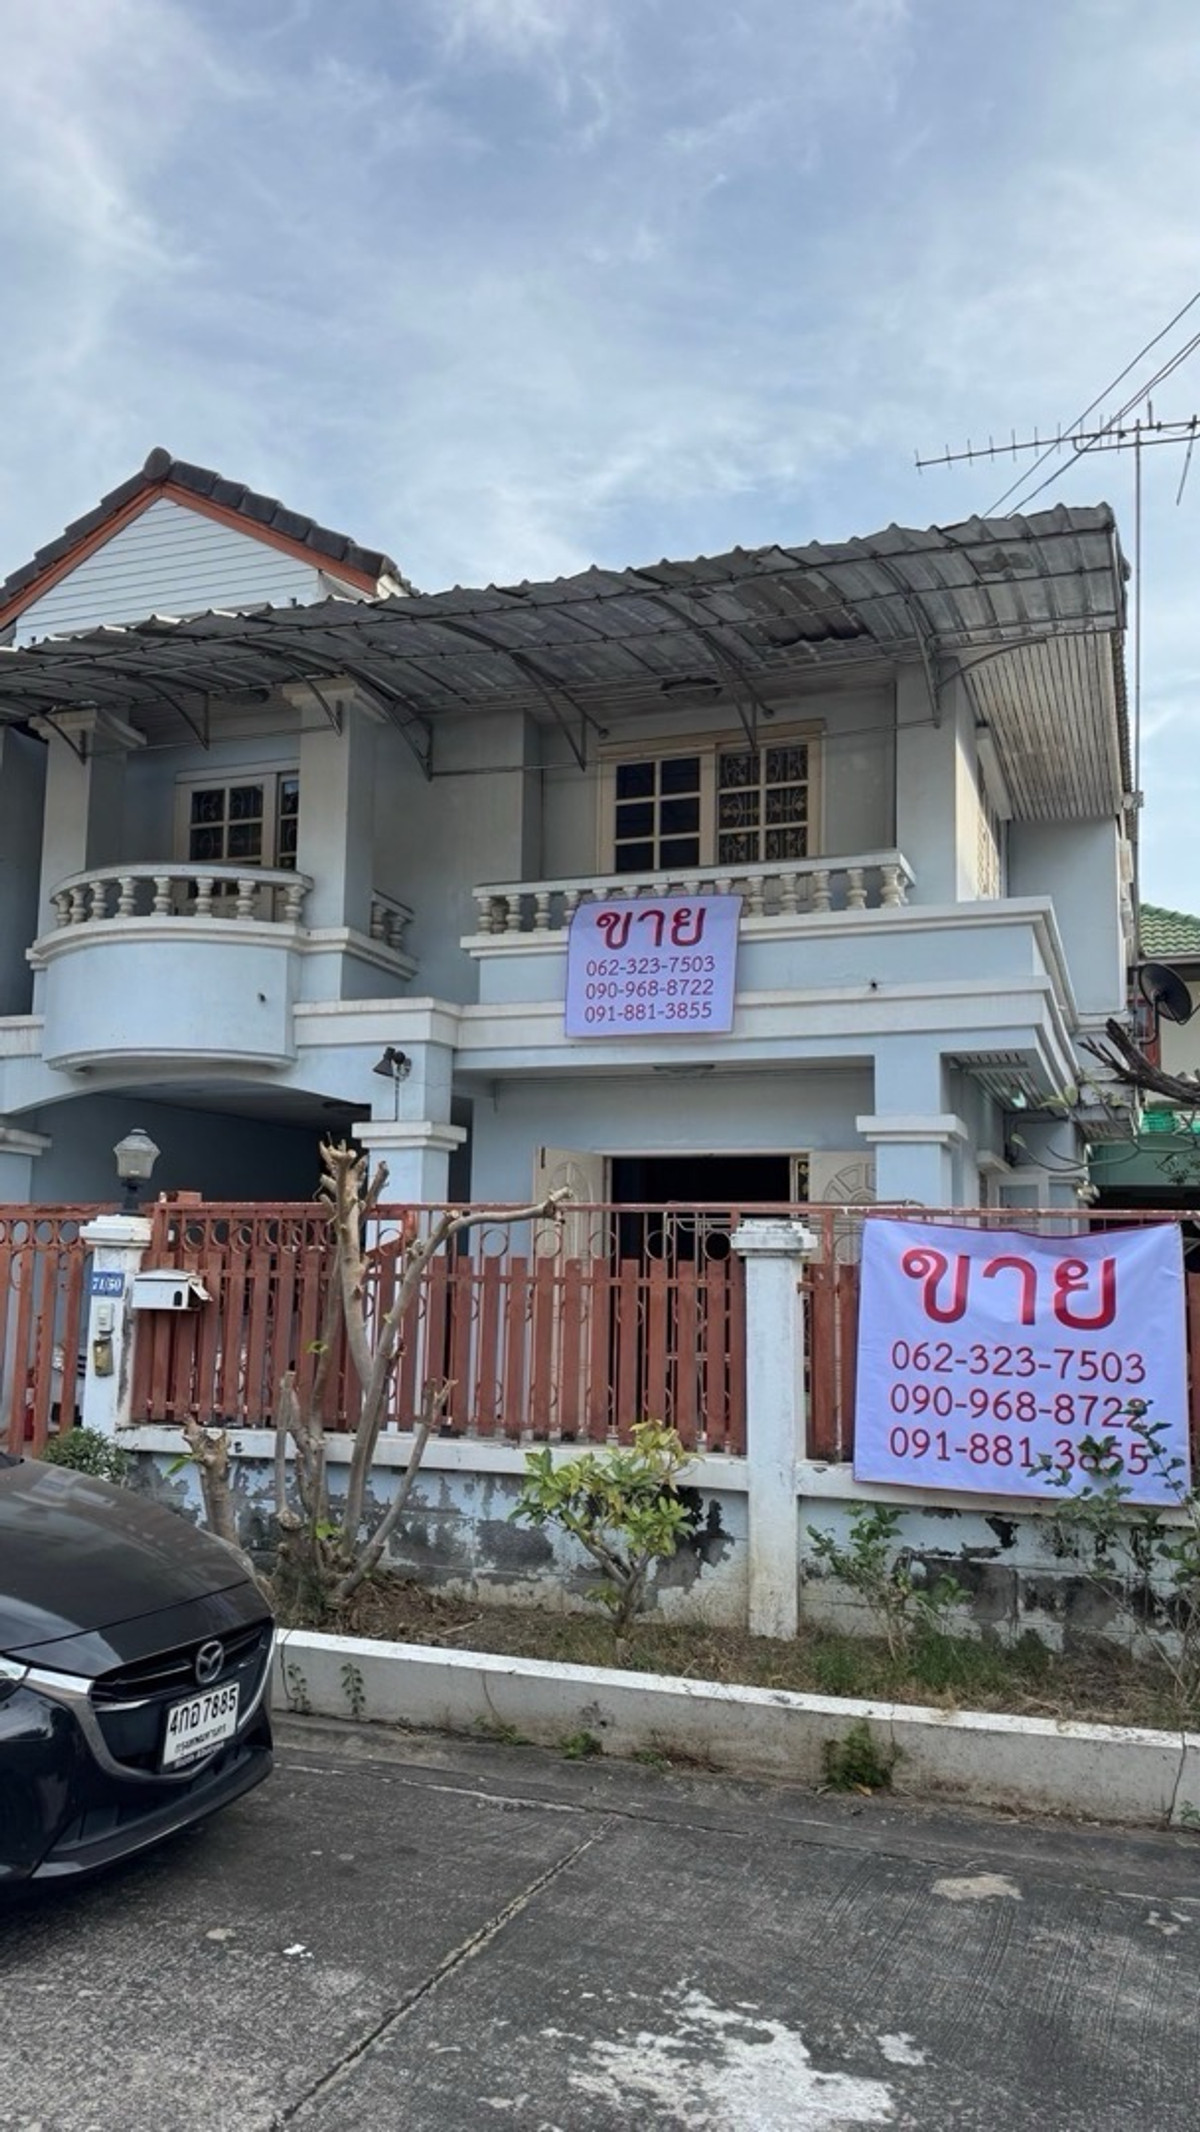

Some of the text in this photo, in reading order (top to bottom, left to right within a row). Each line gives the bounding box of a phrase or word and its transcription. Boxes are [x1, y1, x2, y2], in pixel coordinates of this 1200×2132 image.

[596, 907, 707, 950] ขาย
[586, 955, 716, 977] 062-323-7503
[585, 978, 714, 1000] 090-968-8722
[584, 1001, 712, 1023] 091-881-3855
[902, 1247, 1117, 1331] ขาย
[891, 1340, 1146, 1384] 062-323-7503
[203, 1687, 237, 1723] 7885
